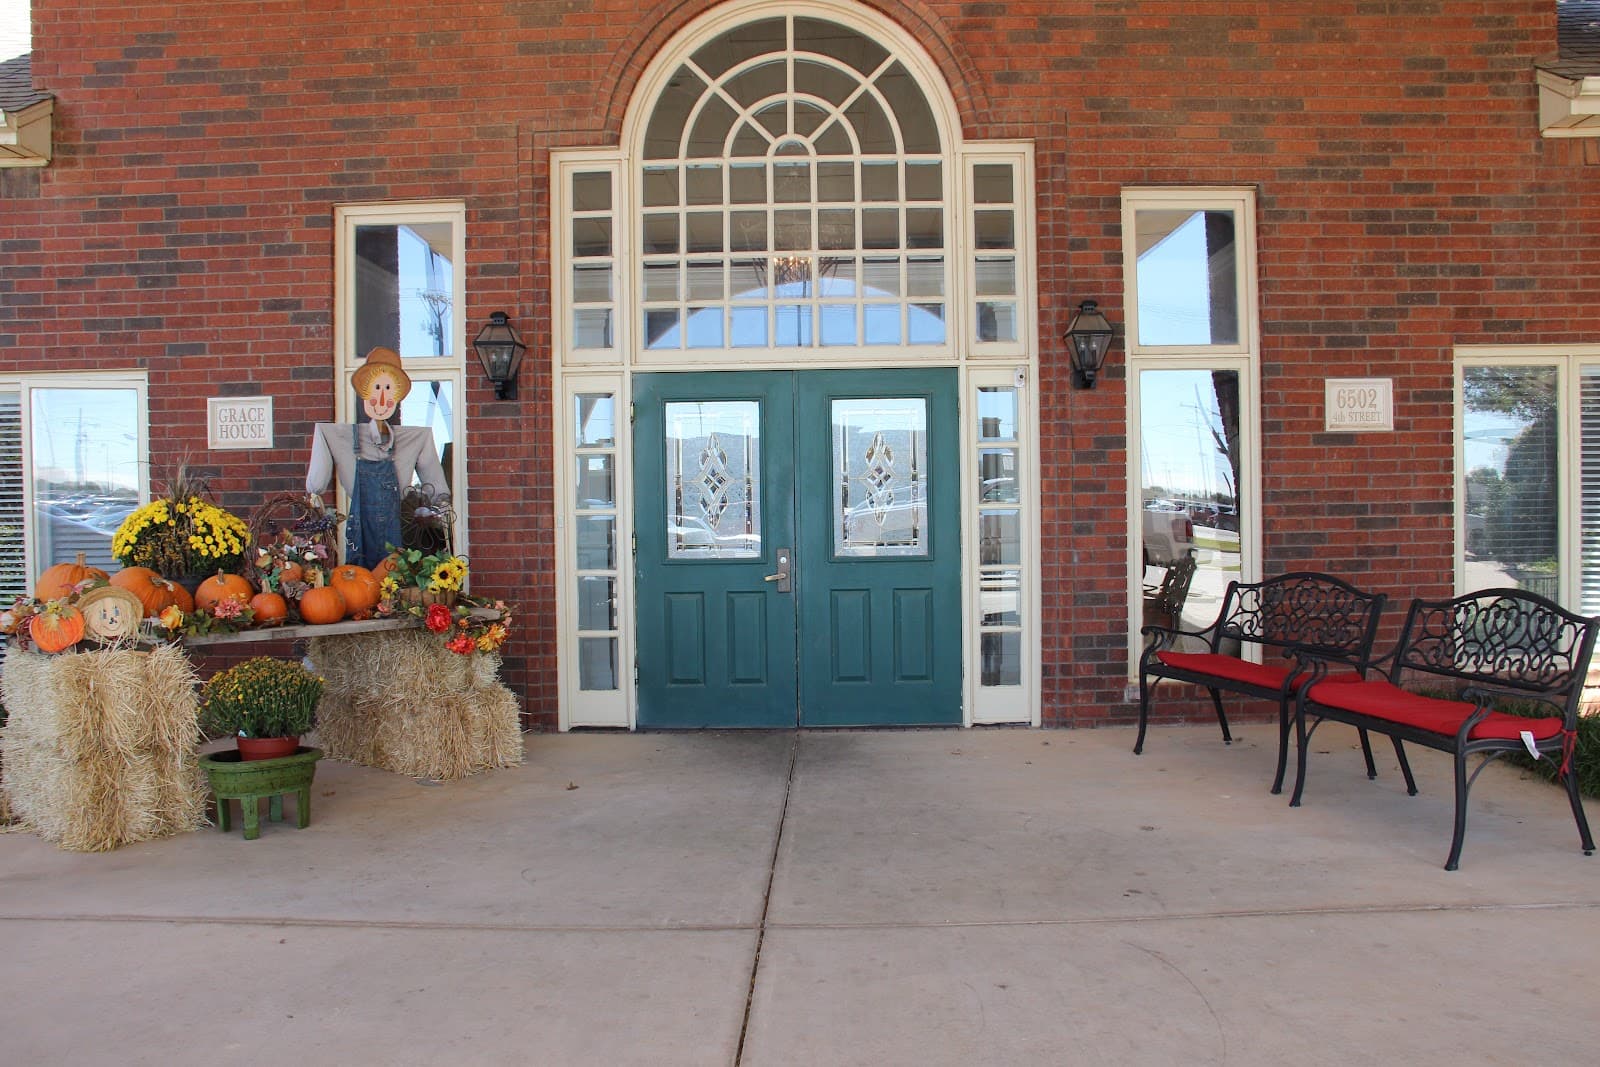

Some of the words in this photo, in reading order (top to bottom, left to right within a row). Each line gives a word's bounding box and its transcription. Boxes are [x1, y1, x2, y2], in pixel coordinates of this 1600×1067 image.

[1336, 388, 1377, 409] 6502
[218, 407, 265, 423] GRACE
[1348, 411, 1382, 422] STREET
[218, 424, 266, 439] HOUSE
